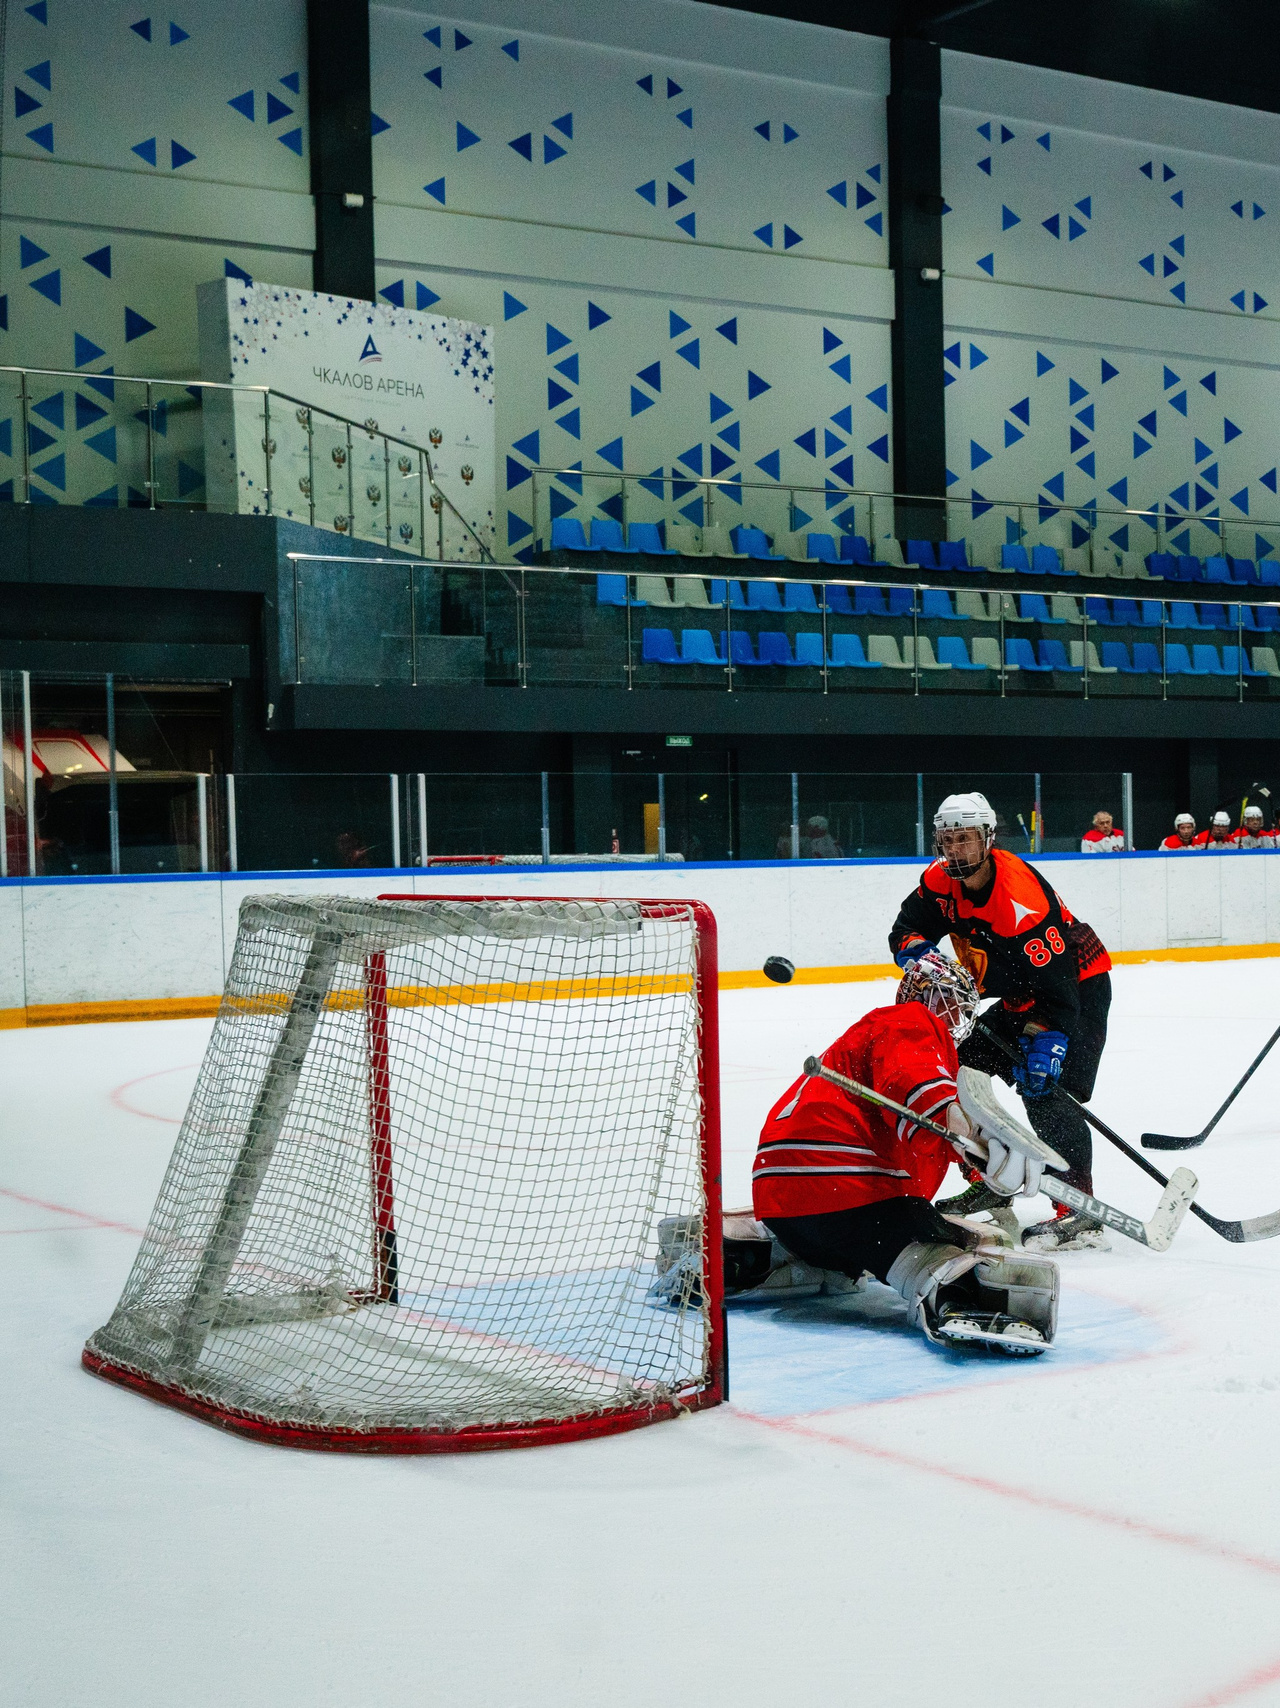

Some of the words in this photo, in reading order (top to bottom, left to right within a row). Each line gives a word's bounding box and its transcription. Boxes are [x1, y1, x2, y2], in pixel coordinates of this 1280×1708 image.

[313, 366, 374, 391] ЧКАЛОВ
[377, 378, 425, 399] АРЕНА
[1024, 926, 1066, 967] 88
